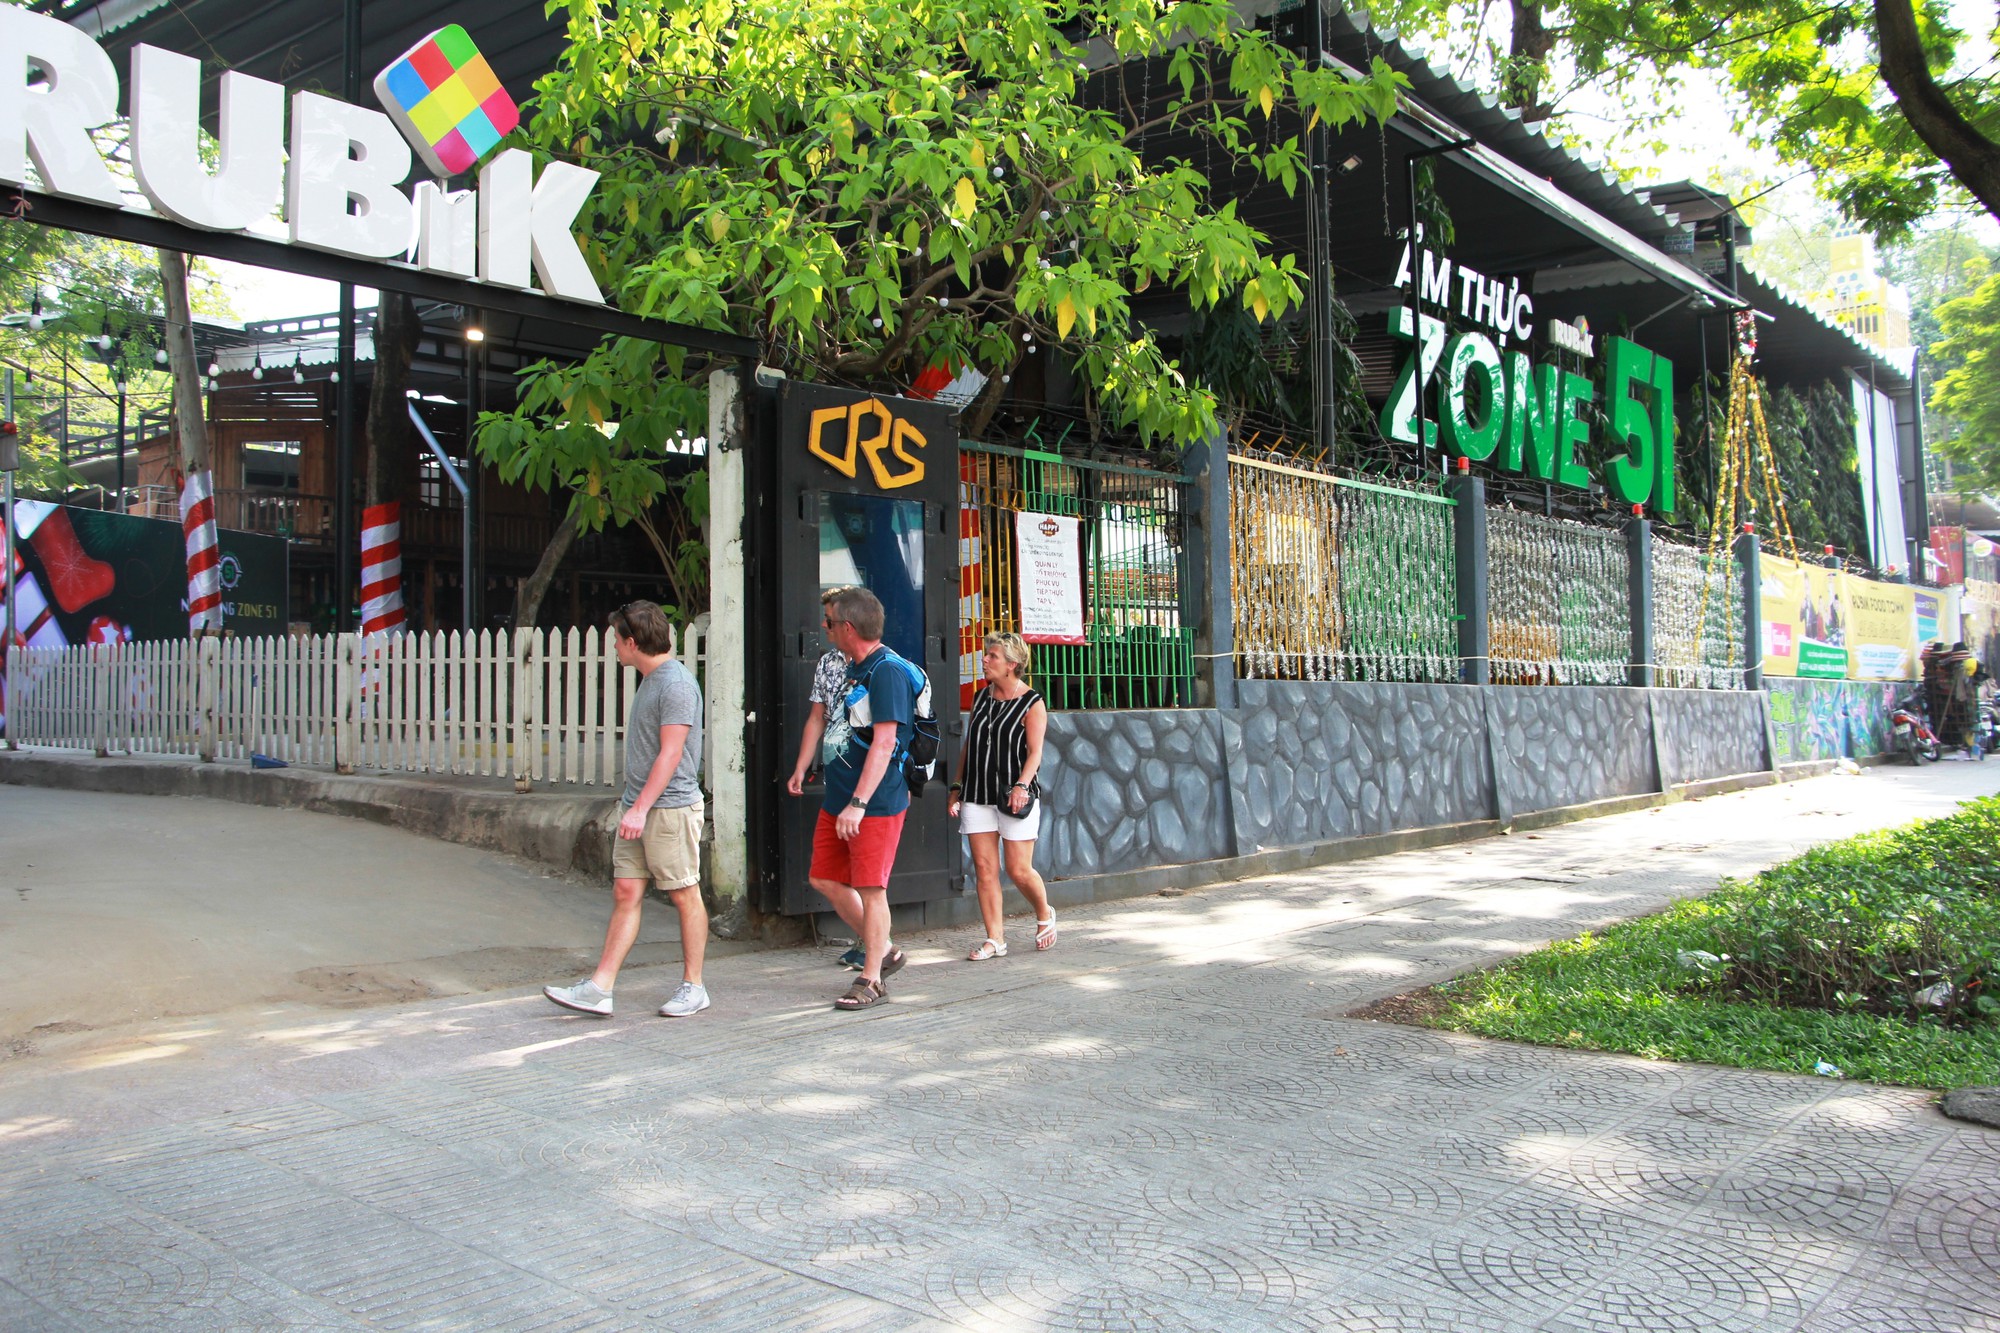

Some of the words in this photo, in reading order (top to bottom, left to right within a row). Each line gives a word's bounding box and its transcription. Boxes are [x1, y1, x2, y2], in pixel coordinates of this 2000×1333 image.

[1457, 264, 1534, 347] THỰC
[1382, 305, 1594, 490] ZONE
[1605, 336, 1674, 513] 51
[1039, 522, 1059, 533] HAPPY
[237, 602, 263, 617] ZONE
[265, 605, 278, 618] 51
